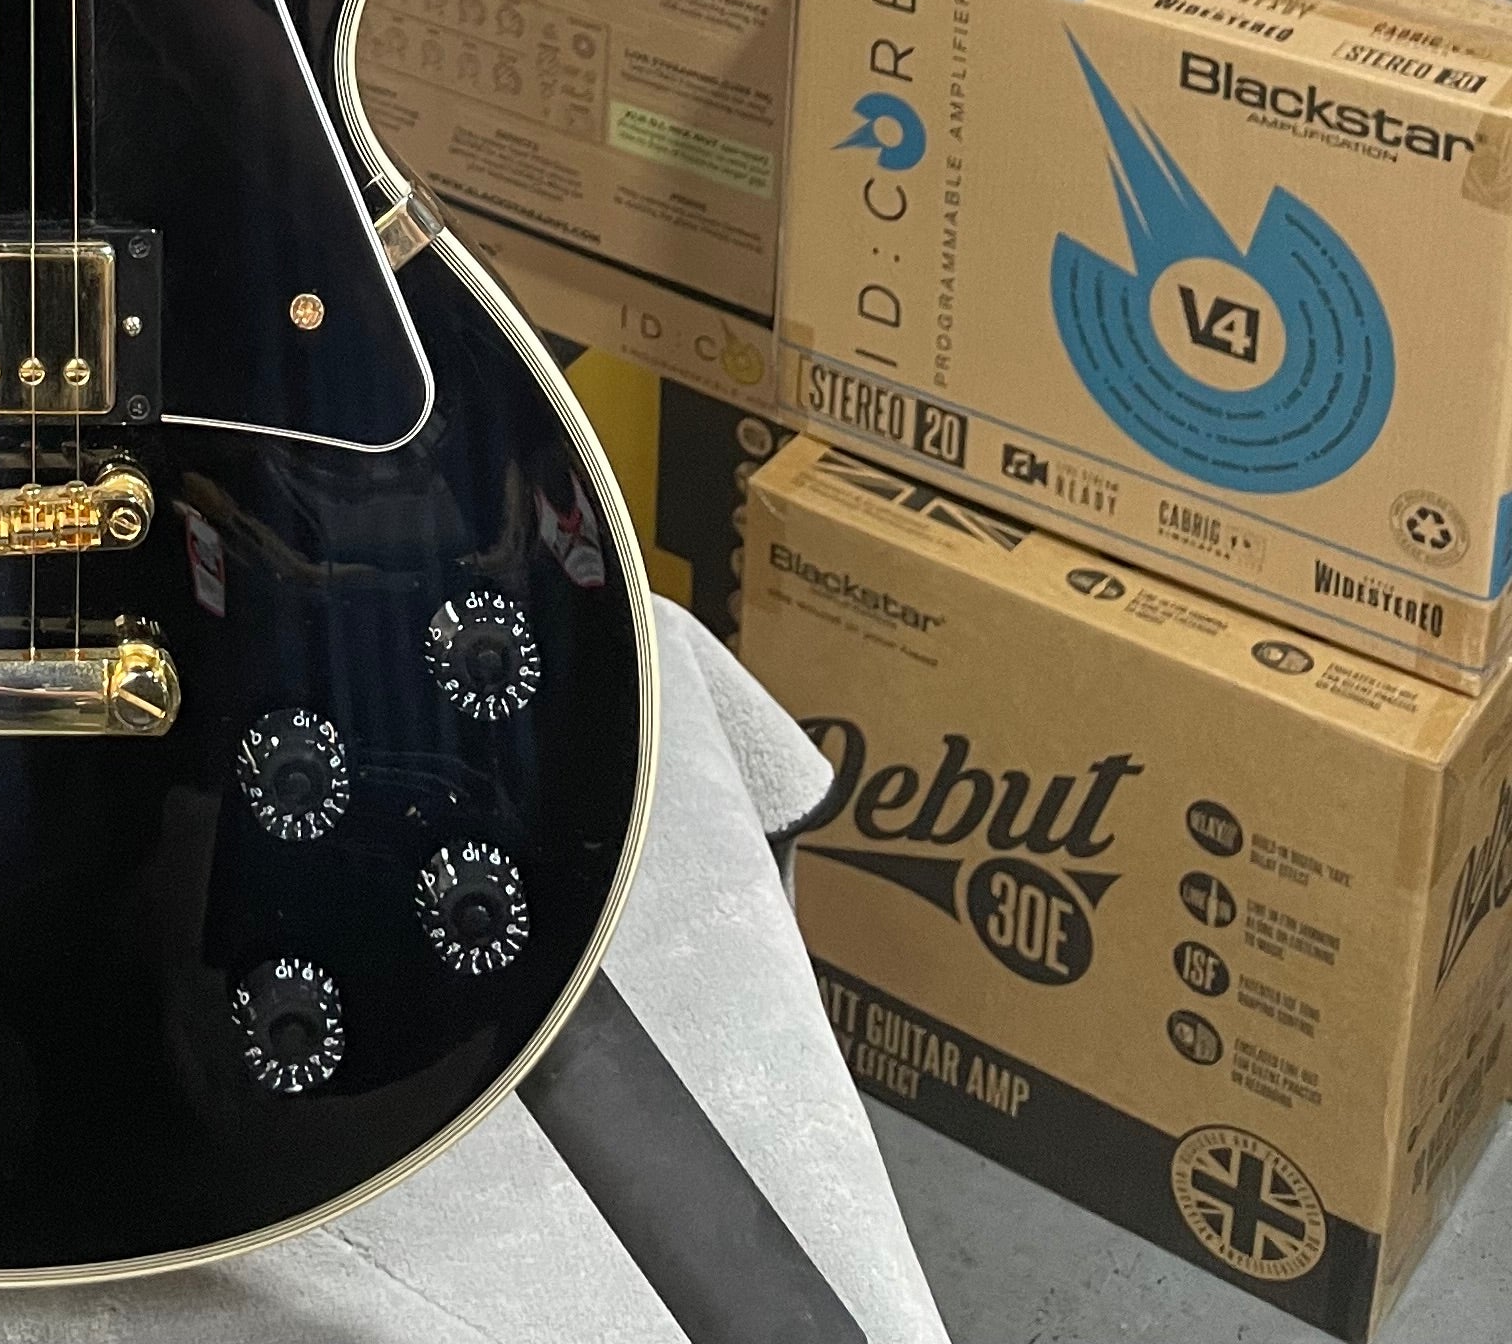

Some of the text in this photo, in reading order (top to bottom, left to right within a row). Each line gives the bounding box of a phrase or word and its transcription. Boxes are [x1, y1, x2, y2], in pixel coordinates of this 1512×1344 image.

[1179, 50, 1475, 163] Blackstar
[1344, 45, 1433, 80] STEREO
[934, 154, 963, 389] PROGRAMMABLE
[1178, 283, 1261, 364] V4
[809, 364, 905, 442] STEREO
[922, 409, 959, 462] 20
[769, 543, 942, 633] Blackstar
[771, 717, 1145, 858] Debut
[988, 871, 1074, 976] 30E
[1182, 944, 1221, 991] ISF
[865, 1002, 961, 1087] GUITAR
[965, 1055, 1031, 1119] AMP
